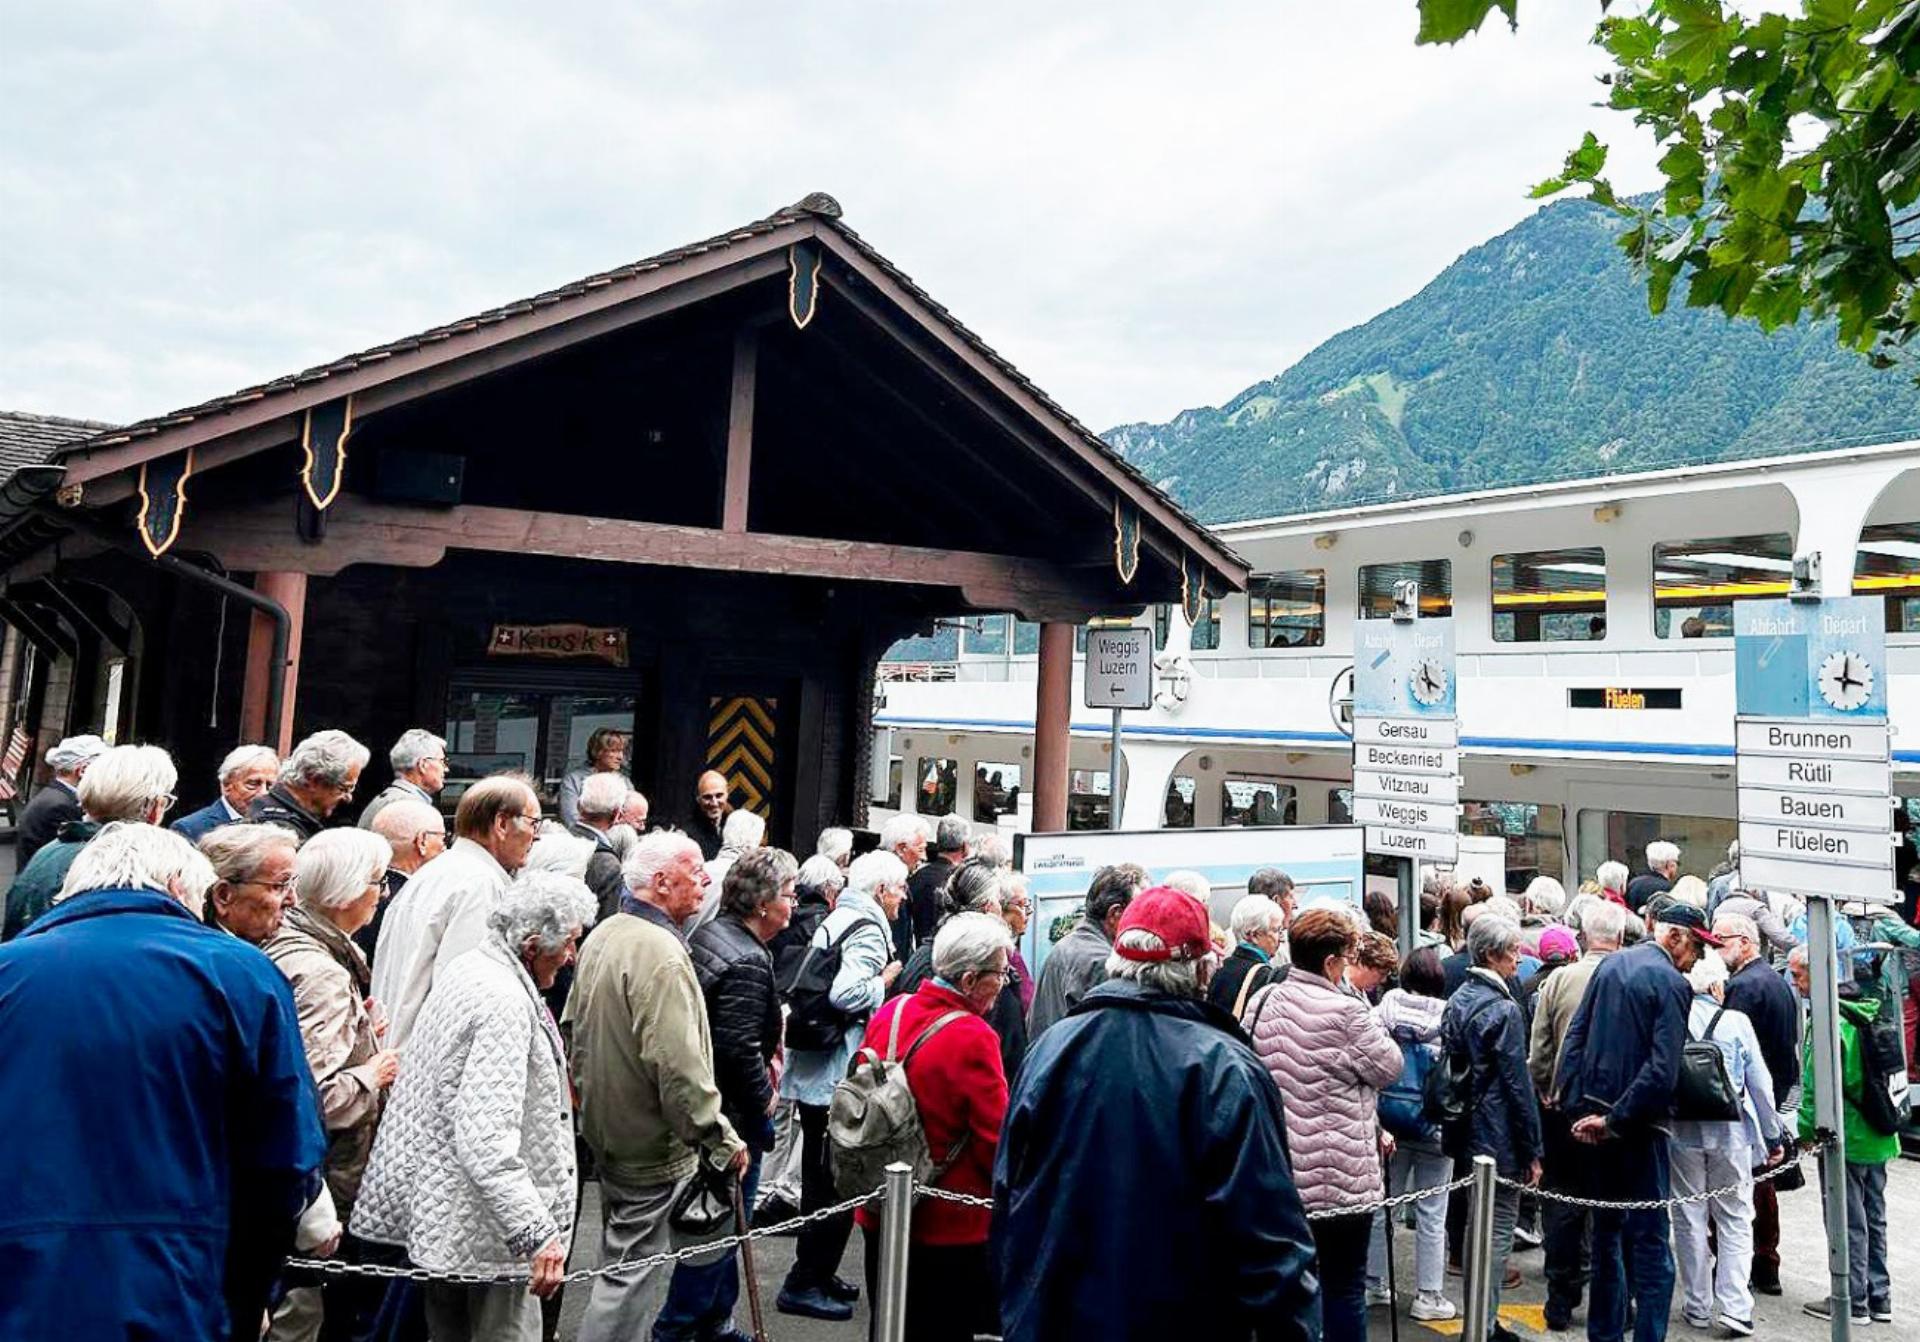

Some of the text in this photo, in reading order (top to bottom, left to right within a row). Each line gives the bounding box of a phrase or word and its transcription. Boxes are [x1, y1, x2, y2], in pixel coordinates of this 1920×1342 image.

[1751, 616, 1796, 635] Abfahrt
[1099, 636, 1140, 659] Weggis
[1099, 658, 1138, 675] Luzern
[1605, 687, 1646, 709] Flüelen
[1378, 721, 1429, 740] Gersau
[1767, 726, 1852, 750] Brunnen
[1367, 747, 1443, 770] Beckenried
[1788, 761, 1833, 784] Rütli
[1378, 775, 1430, 796] Vitznau
[1377, 802, 1429, 825] Weggis
[1779, 795, 1845, 820] Bauen
[1379, 830, 1427, 850] Luzern
[1776, 828, 1850, 854] Flüelen
